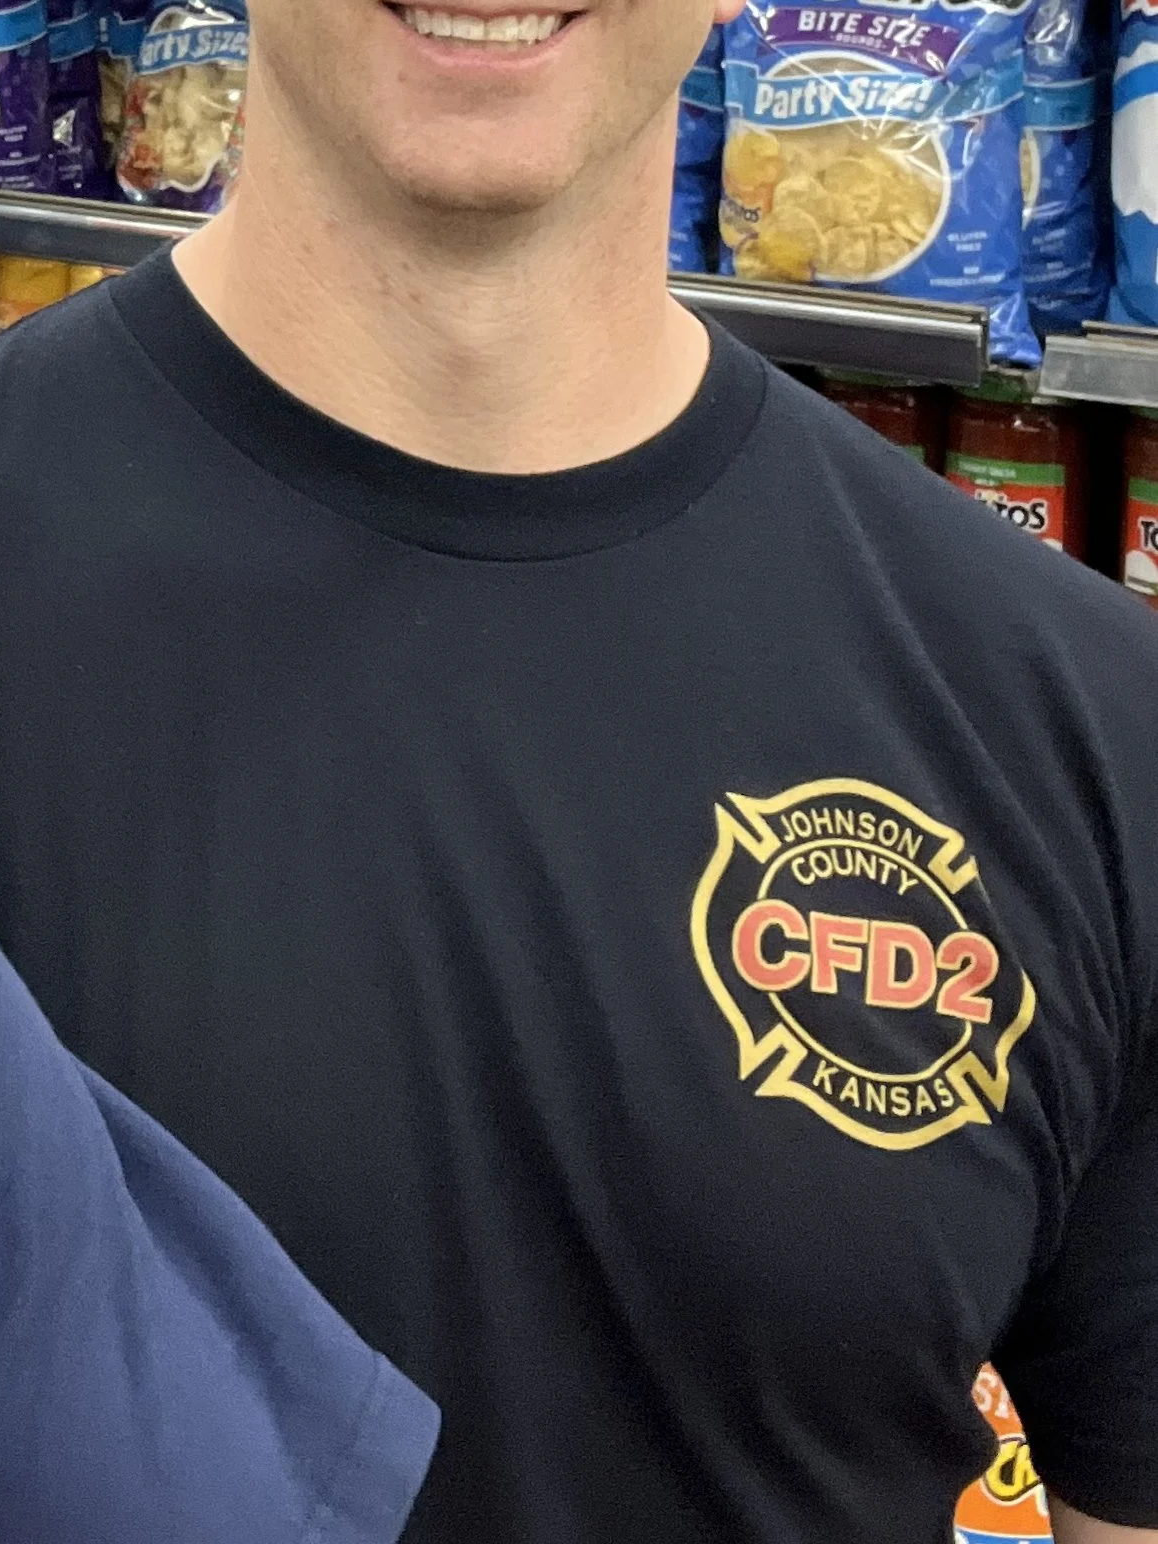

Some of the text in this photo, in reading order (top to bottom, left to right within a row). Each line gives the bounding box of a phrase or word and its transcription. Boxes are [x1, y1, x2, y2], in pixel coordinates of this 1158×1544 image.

[141, 26, 248, 67] arty Size
[797, 10, 931, 47] BITE SIZE
[754, 80, 840, 120] Party
[778, 807, 923, 859] JOHNSON
[792, 847, 918, 896] COUNTY
[731, 898, 1000, 1025] CFD2
[812, 1060, 955, 1117] KANSAS
